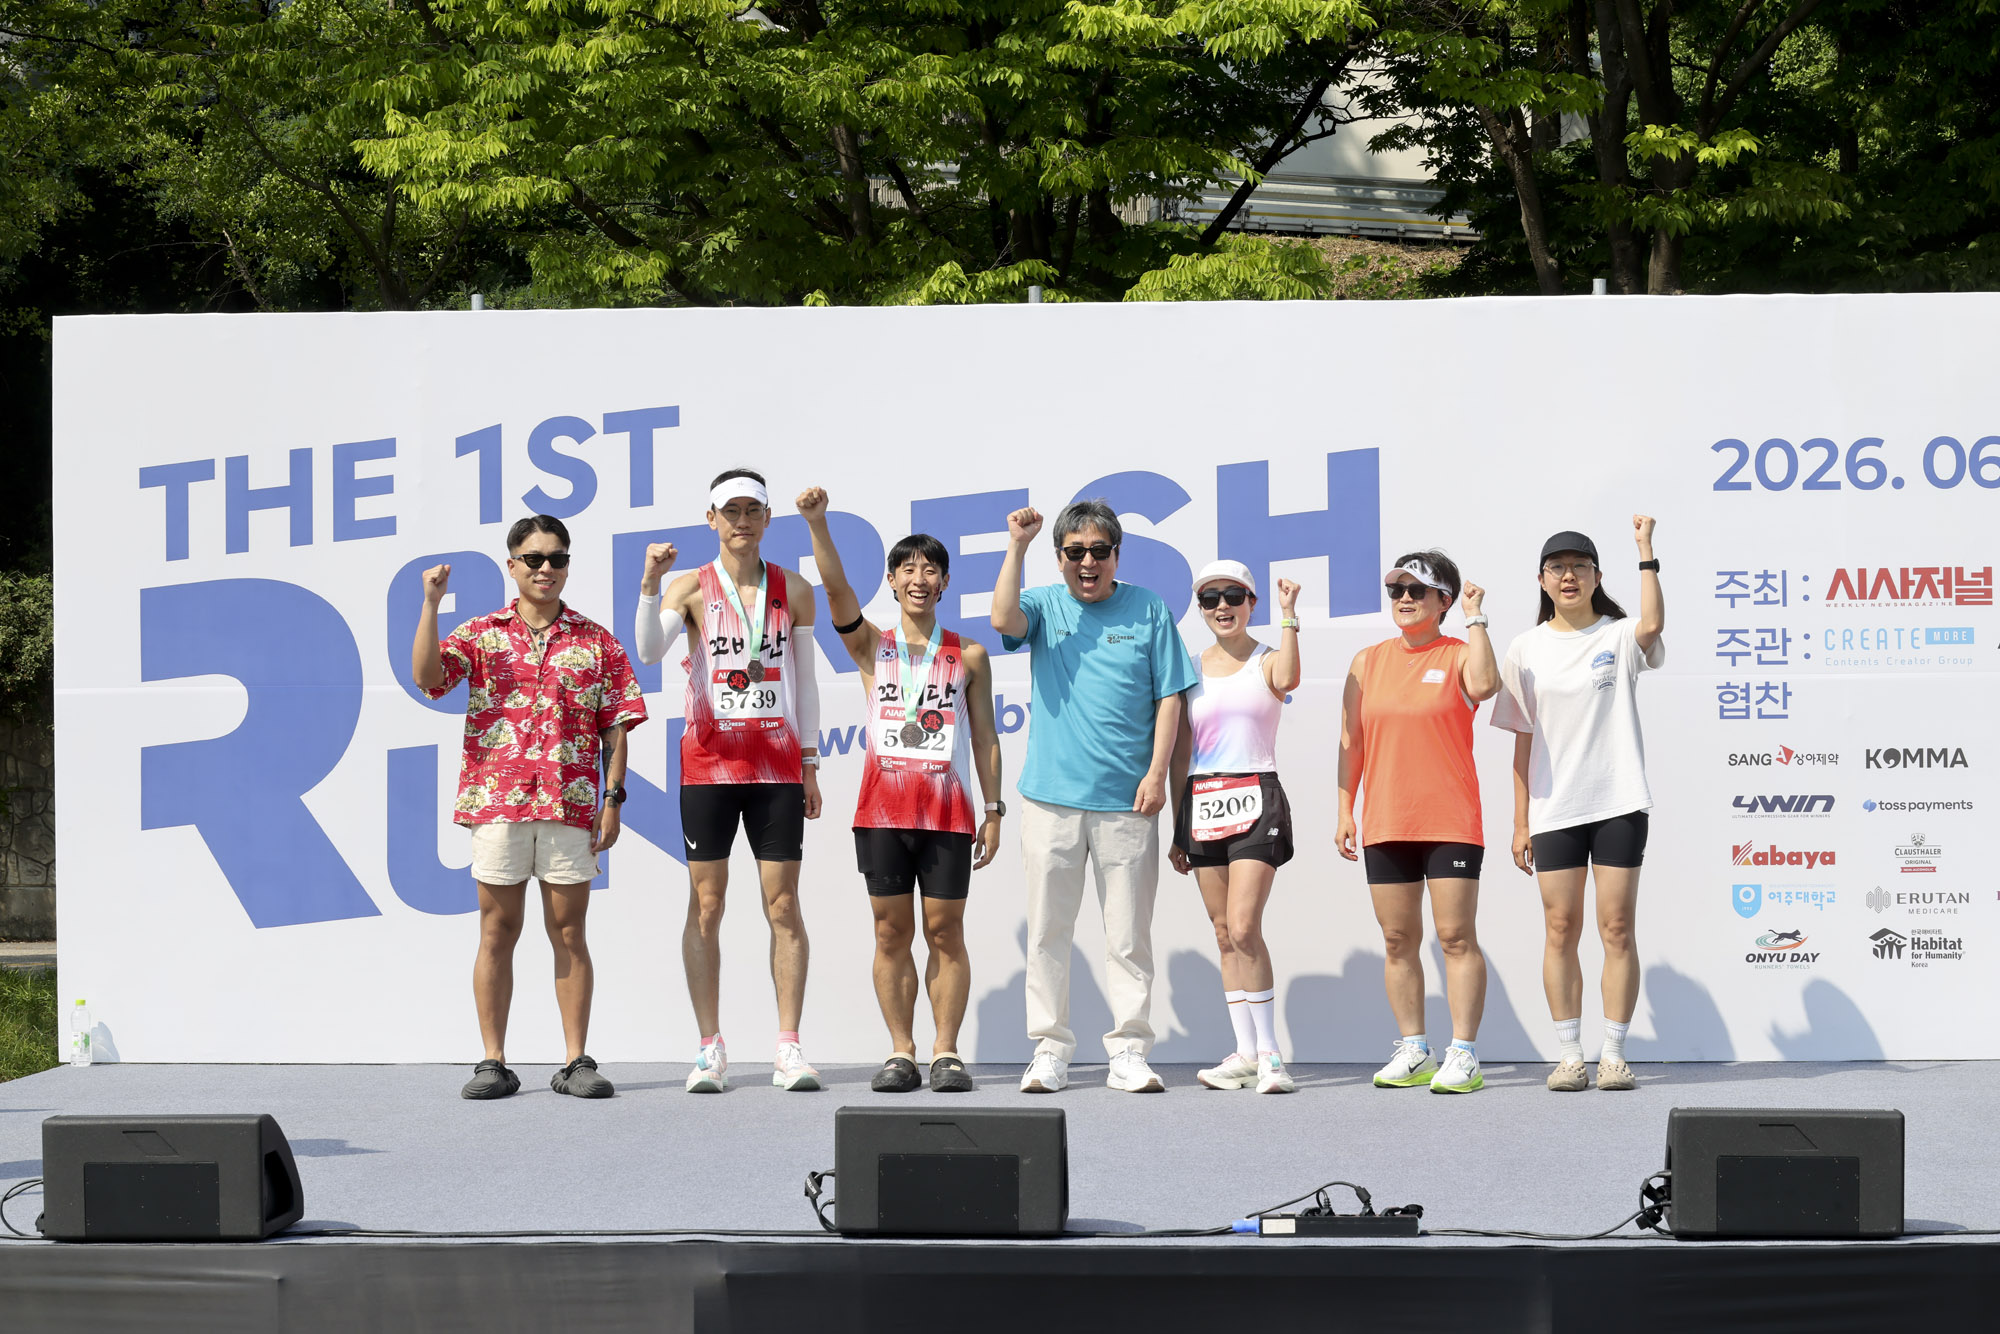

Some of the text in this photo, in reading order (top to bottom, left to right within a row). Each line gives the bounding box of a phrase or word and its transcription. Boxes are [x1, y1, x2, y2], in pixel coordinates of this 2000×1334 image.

[1711, 437, 1905, 491] 2026.
[139, 405, 680, 562] THE 1ST
[1715, 570, 1787, 608] 주최
[1825, 566, 1993, 606] 시사저널
[1715, 628, 1792, 667] 주관
[1824, 628, 1921, 650] CREATE
[1933, 631, 1967, 641] MORE
[1825, 655, 1973, 666] Contents Creator Group
[720, 690, 776, 710] 5739
[878, 682, 957, 710] 꼬단
[1716, 681, 1792, 719] 협찬
[760, 720, 779, 728] 5 km
[883, 729, 946, 751] 522
[1794, 753, 1839, 765] 상아제약
[1199, 795, 1256, 820] 5200
[1878, 800, 1973, 813] toss payments
[1732, 840, 1835, 869] Kabaya
[1768, 891, 1836, 911] 여주대학교
[1897, 892, 1970, 904] ERUTAN
[1911, 937, 1962, 950] Habitat
[1745, 953, 1821, 963] ONYU DAY
[1911, 952, 1923, 960] for
